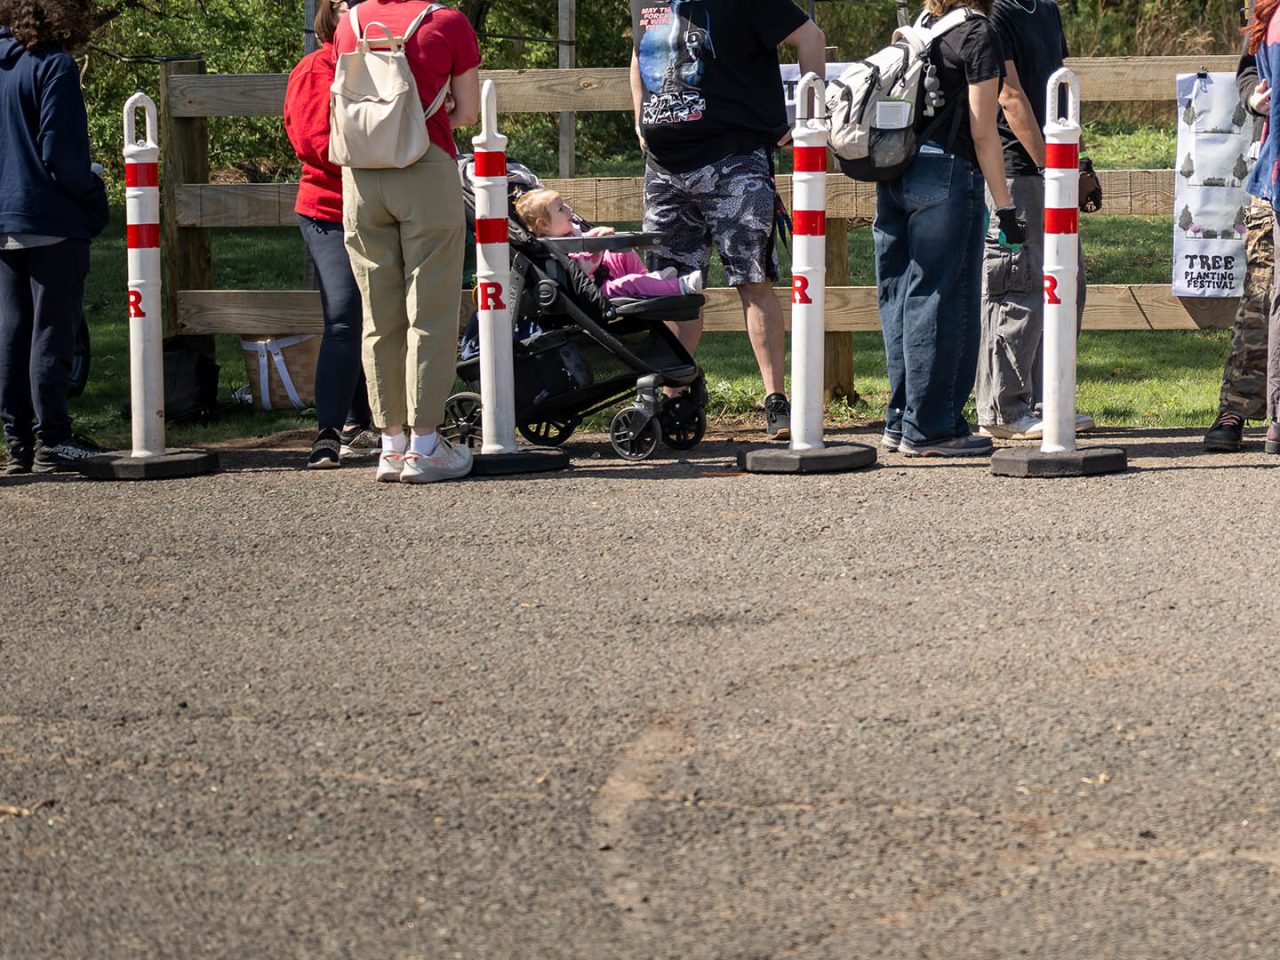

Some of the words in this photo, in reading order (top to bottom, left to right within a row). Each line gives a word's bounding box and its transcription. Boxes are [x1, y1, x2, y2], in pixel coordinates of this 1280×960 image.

[1184, 254, 1235, 271] TREE
[1184, 271, 1234, 281] PLANTING
[480, 282, 506, 310] R
[791, 275, 812, 304] R
[1043, 275, 1061, 304] R
[1187, 280, 1235, 290] FESTIVAL
[128, 290, 146, 317] R
